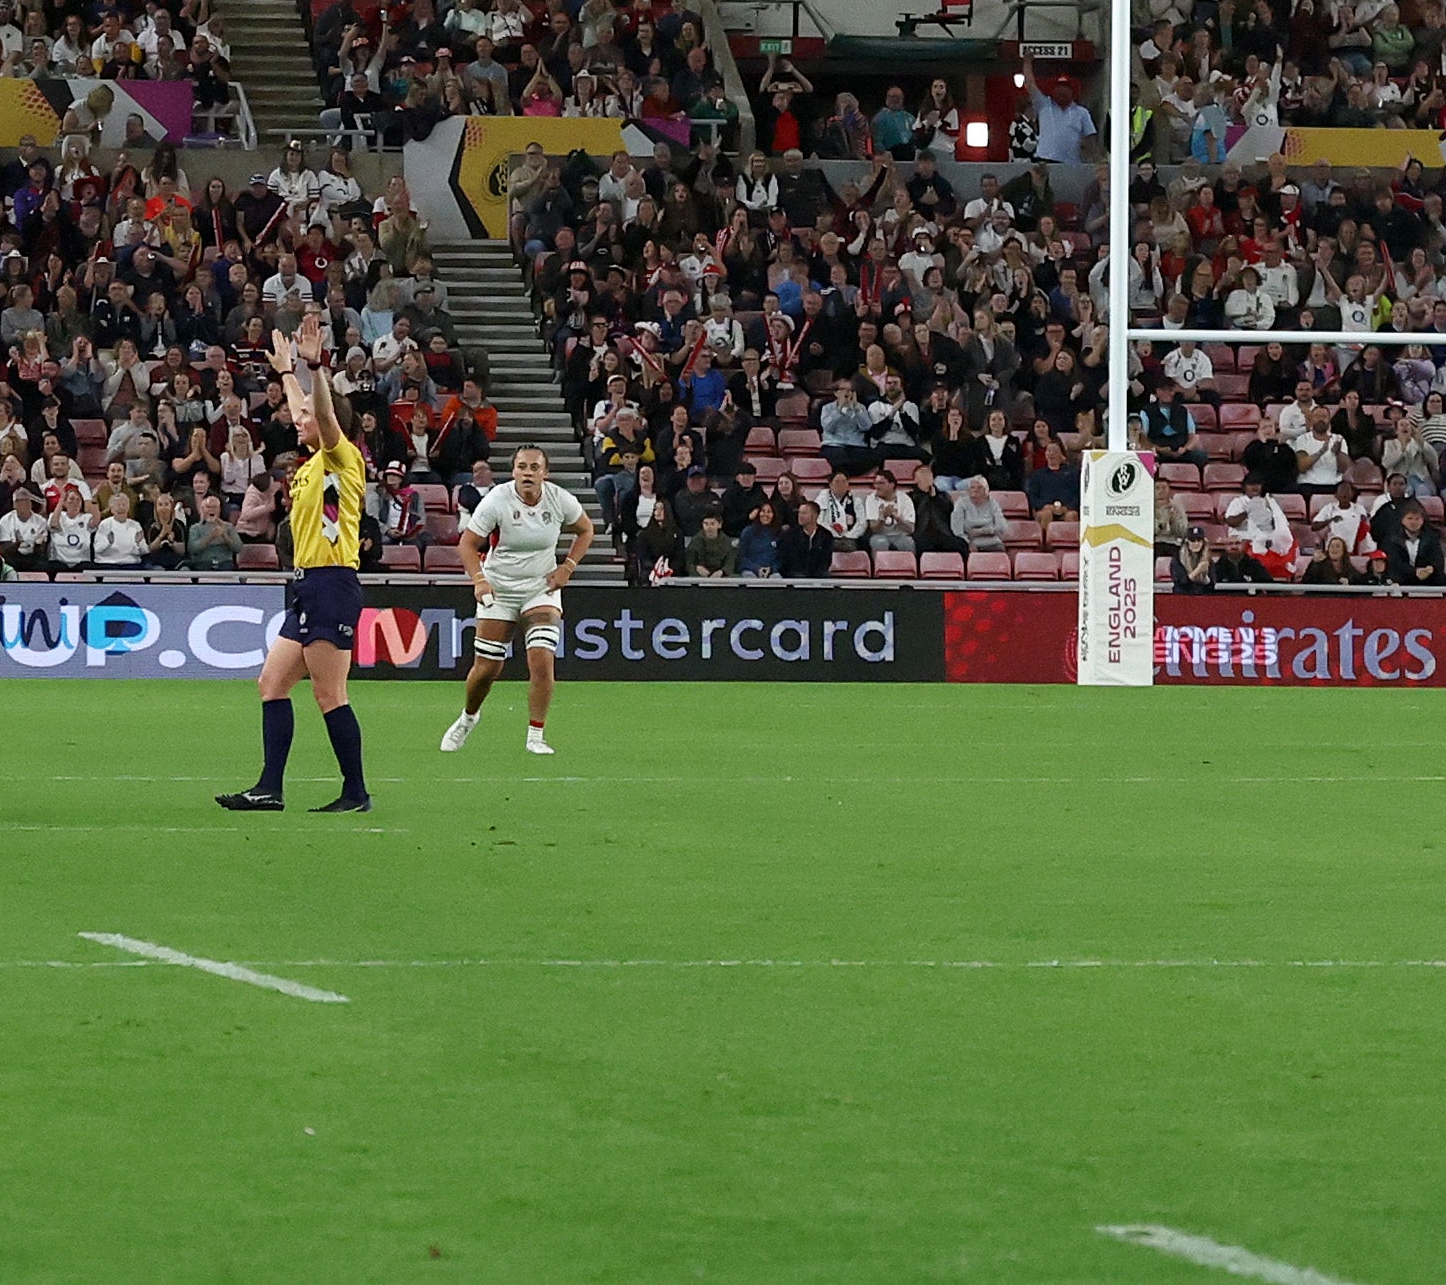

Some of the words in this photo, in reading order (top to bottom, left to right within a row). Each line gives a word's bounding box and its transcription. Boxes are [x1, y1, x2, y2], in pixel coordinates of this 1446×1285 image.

[452, 609, 896, 664] stercard
[1108, 546, 1122, 664] ENGLAND
[1124, 578, 1137, 639] 2025
[1153, 609, 1437, 681] mirates
